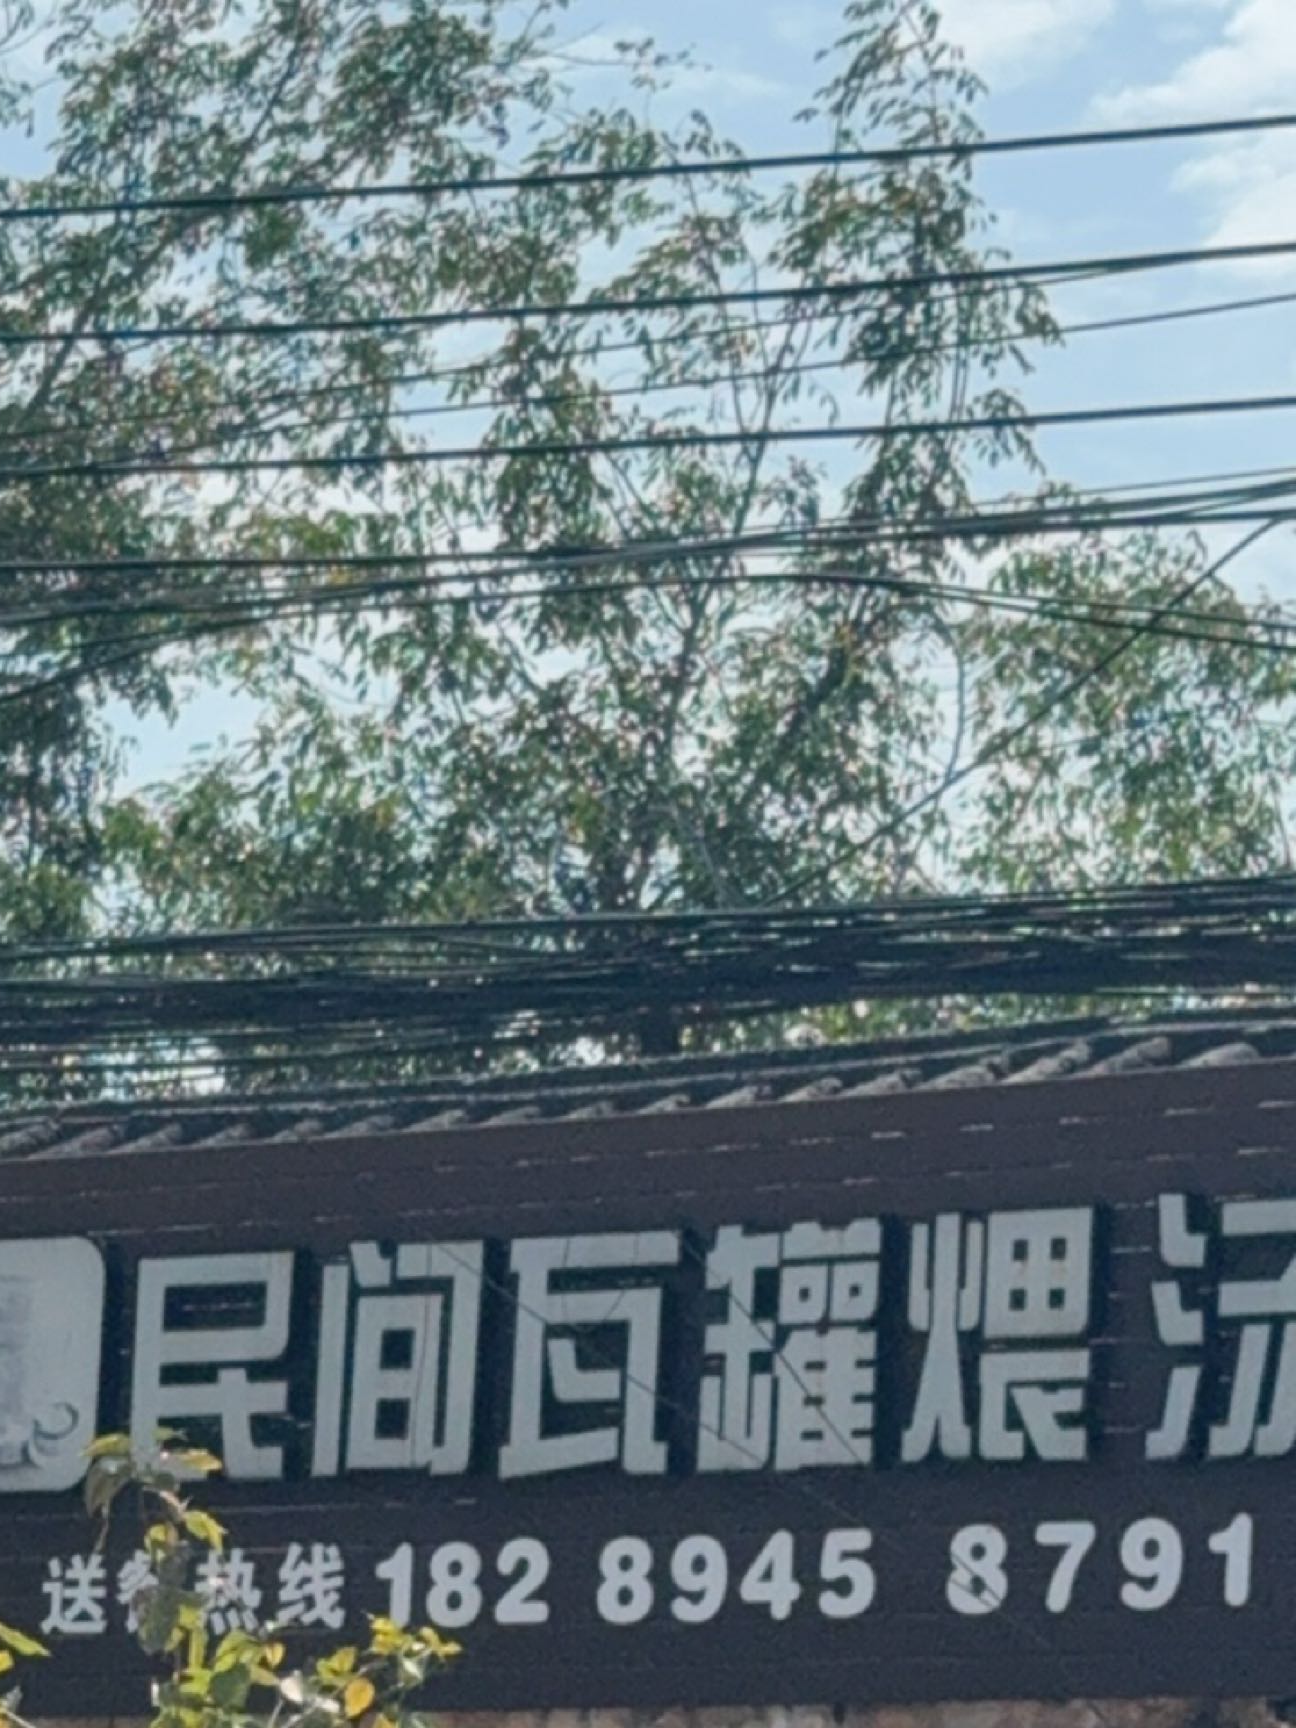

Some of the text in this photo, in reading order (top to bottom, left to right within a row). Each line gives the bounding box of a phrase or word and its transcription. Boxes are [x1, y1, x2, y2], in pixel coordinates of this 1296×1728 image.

[131, 1193, 1296, 1479] 民间瓦罐煨汤
[375, 1537, 549, 1628] 182
[597, 1528, 875, 1625] 8945
[946, 1512, 1254, 1615] 8791
